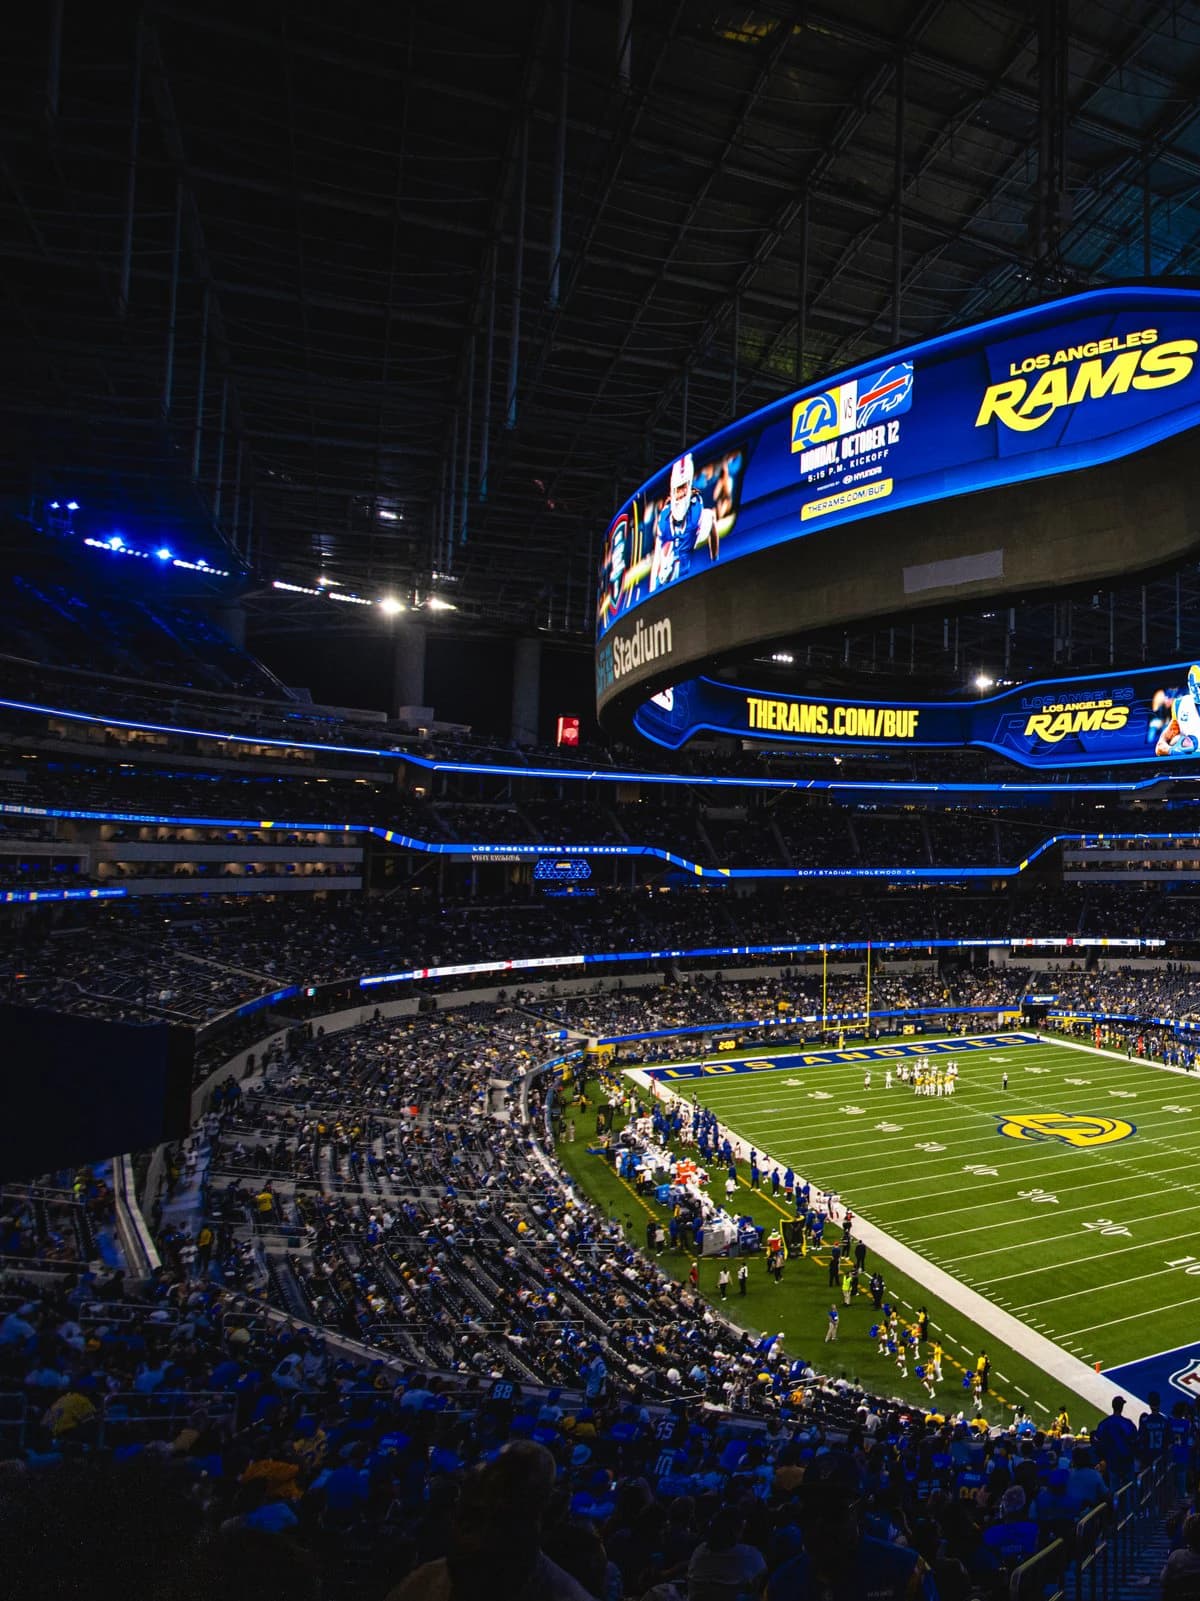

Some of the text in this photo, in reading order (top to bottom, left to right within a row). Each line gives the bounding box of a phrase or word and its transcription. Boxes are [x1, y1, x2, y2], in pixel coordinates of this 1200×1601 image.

[1010, 328, 1158, 377] LOS ANGELES
[975, 339, 1199, 432] RAMS
[841, 425, 886, 459] OCTOBER
[887, 420, 900, 445] 12
[808, 449, 889, 483] 5:15 P.M. KICKOFF
[808, 484, 886, 513] THERAMS.COM/BUF
[612, 617, 673, 680] Stadium
[747, 697, 919, 738] THERAMS.COM/BUF
[1024, 706, 1130, 743] RAMS
[1042, 699, 1113, 713] LOS ANGELES
[665, 1036, 1026, 1078] LOS ANGELES
[1017, 1188, 1060, 1204] 30
[1081, 1218, 1133, 1237] 20
[493, 1383, 513, 1400] 88
